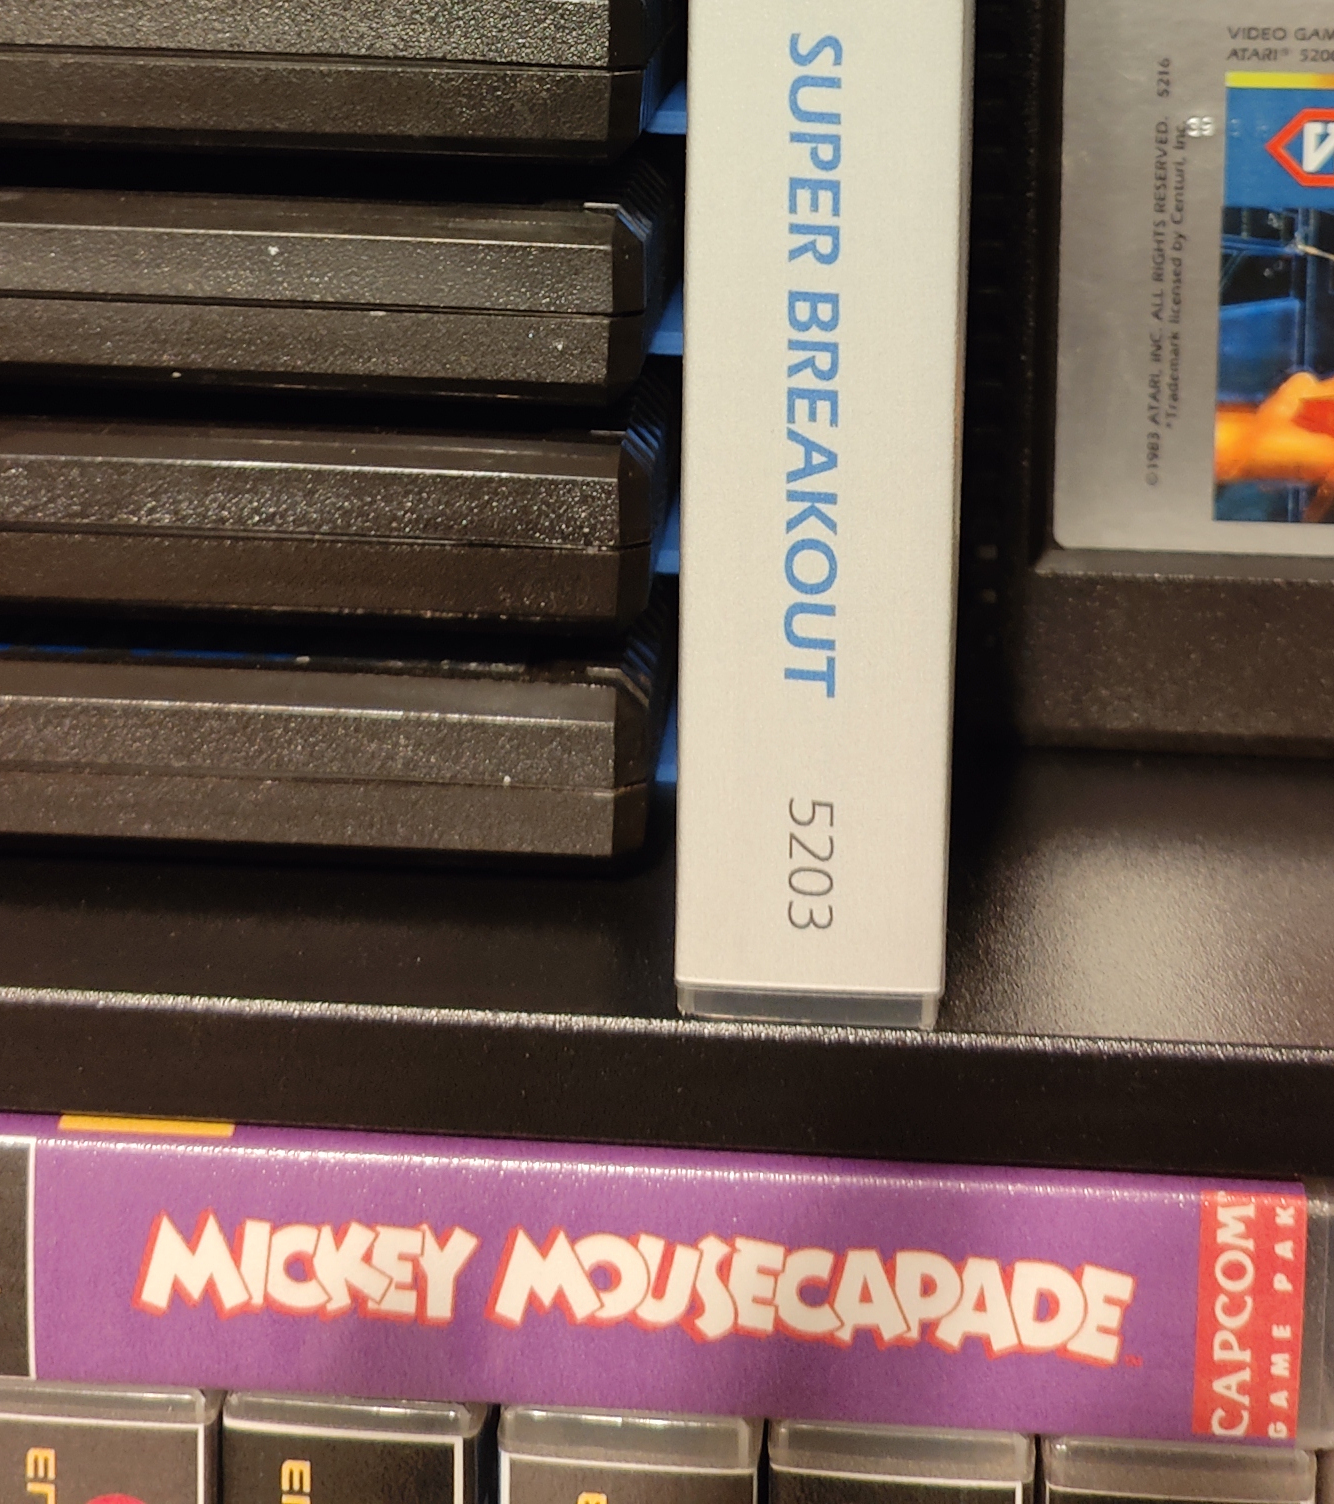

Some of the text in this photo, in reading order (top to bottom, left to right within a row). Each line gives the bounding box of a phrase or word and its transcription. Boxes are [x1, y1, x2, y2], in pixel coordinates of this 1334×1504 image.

[1227, 26, 1287, 41] VIDEO
[1156, 57, 1171, 98] 5216
[1152, 220, 1166, 283] RIGHTS
[1171, 232, 1187, 253] by
[1151, 289, 1165, 321] ALL
[1168, 257, 1183, 325] licensed
[783, 33, 843, 698] SUPER BREAKOUT
[787, 797, 835, 932] 5203
[131, 1206, 1137, 1368] MICKEY MOUSECAPADE
[1211, 1190, 1256, 1437] CAPCOM
[1268, 1205, 1296, 1439] GAME PAK
